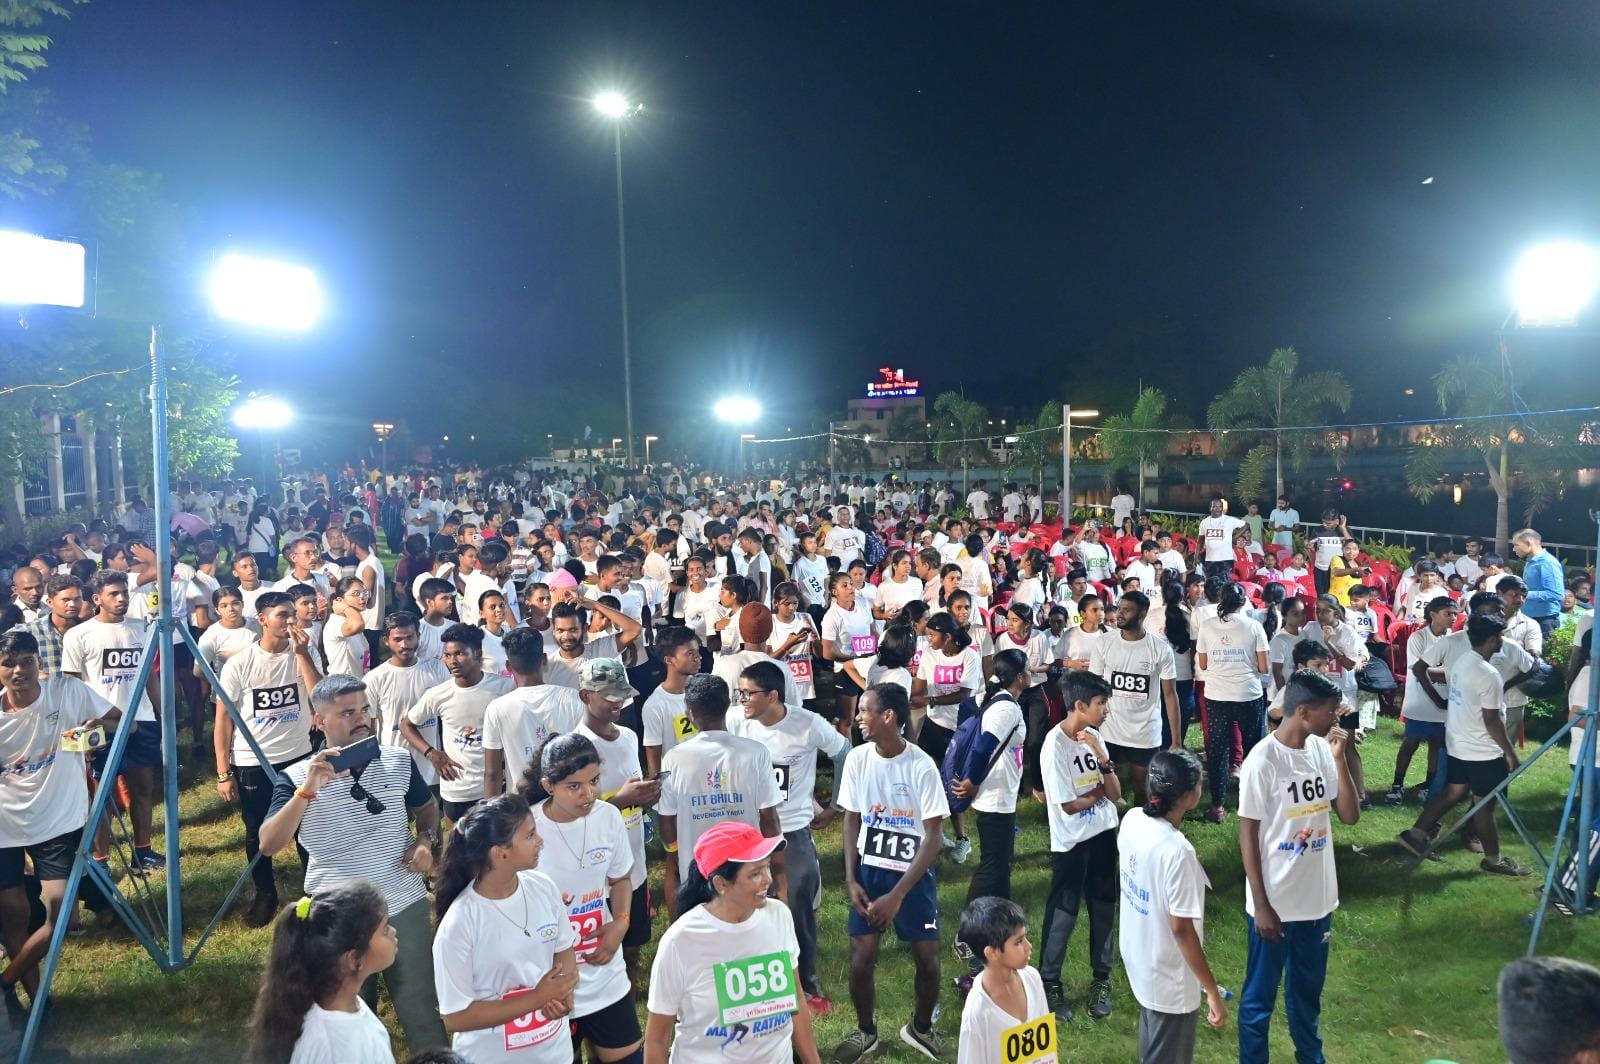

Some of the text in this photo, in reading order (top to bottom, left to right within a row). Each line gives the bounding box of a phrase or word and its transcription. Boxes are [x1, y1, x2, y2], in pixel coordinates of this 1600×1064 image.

[1207, 529, 1221, 537] 241
[808, 576, 823, 593] 325
[1357, 616, 1373, 626] 261
[854, 637, 874, 651] 109
[107, 651, 141, 668] 060
[1114, 674, 1146, 691] 083
[257, 687, 296, 708] 392
[1073, 752, 1098, 774] 16
[1287, 776, 1325, 804] 166
[691, 792, 744, 807] FIT BHILAI
[692, 811, 726, 821] DEVENDRA
[872, 832, 915, 860] 113
[724, 959, 788, 1002] 058
[706, 1026, 728, 1038] MA
[1006, 1022, 1050, 1063] 080
